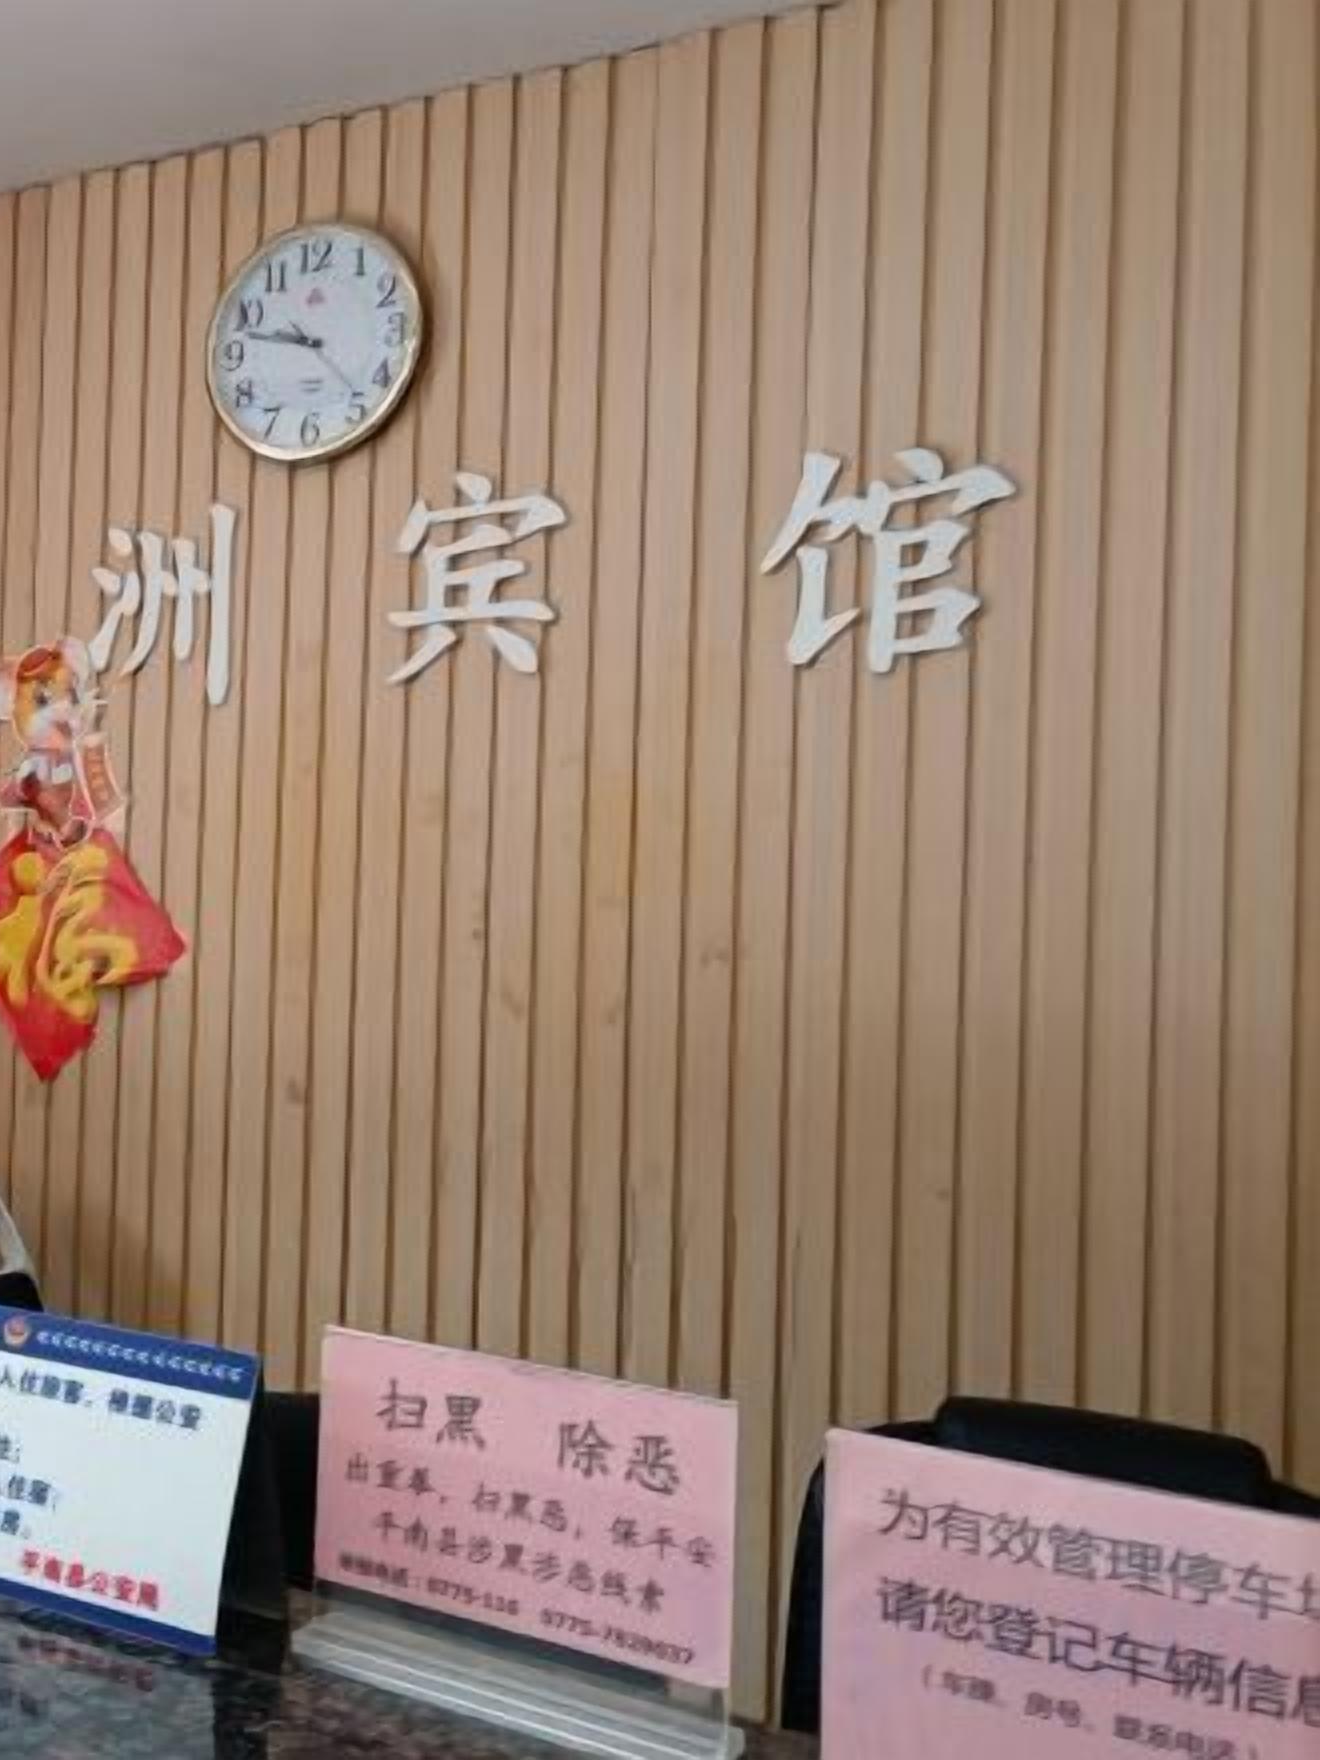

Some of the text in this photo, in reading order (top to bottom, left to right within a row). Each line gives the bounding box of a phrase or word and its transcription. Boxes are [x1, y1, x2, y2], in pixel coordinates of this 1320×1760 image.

[300, 241, 332, 273] 12
[354, 246, 366, 276] 1
[265, 262, 287, 292] 11
[377, 275, 396, 308] 2
[234, 299, 264, 332] 10
[386, 312, 405, 346] 3
[220, 340, 244, 371] 9
[372, 357, 392, 388] 4
[235, 379, 253, 408] 8
[346, 391, 366, 423] 5
[264, 406, 282, 438] 7
[300, 411, 320, 446] 6
[376, 1378, 681, 1496] 扫黑 除恶
